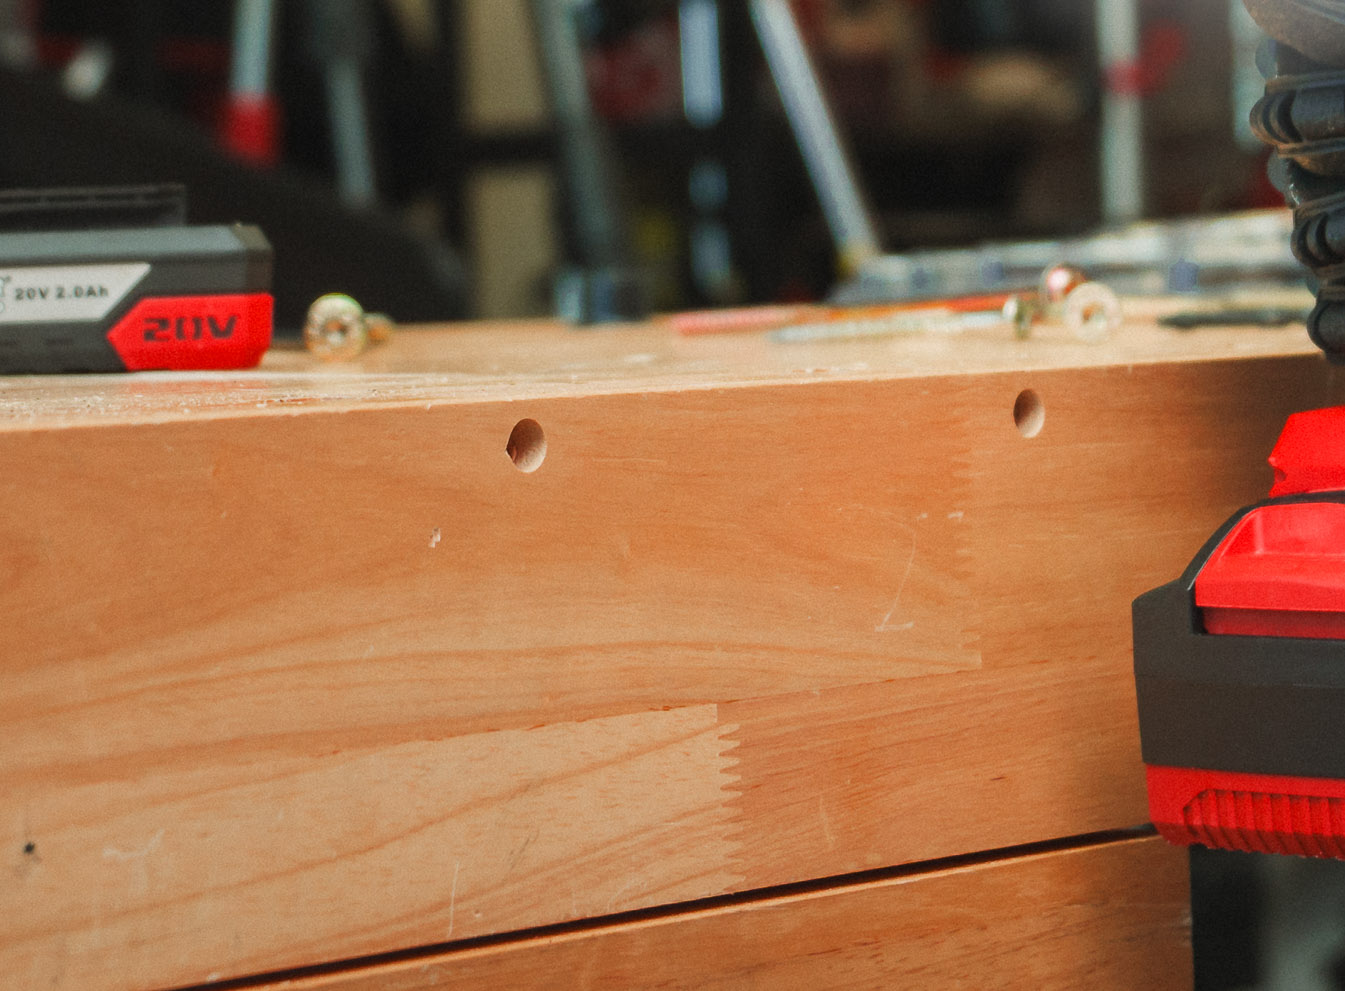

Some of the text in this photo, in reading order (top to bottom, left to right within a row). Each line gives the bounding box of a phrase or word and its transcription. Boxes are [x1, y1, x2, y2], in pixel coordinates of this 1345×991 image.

[15, 285, 109, 300] 20V 2.0Ah
[143, 315, 238, 343] 20V
